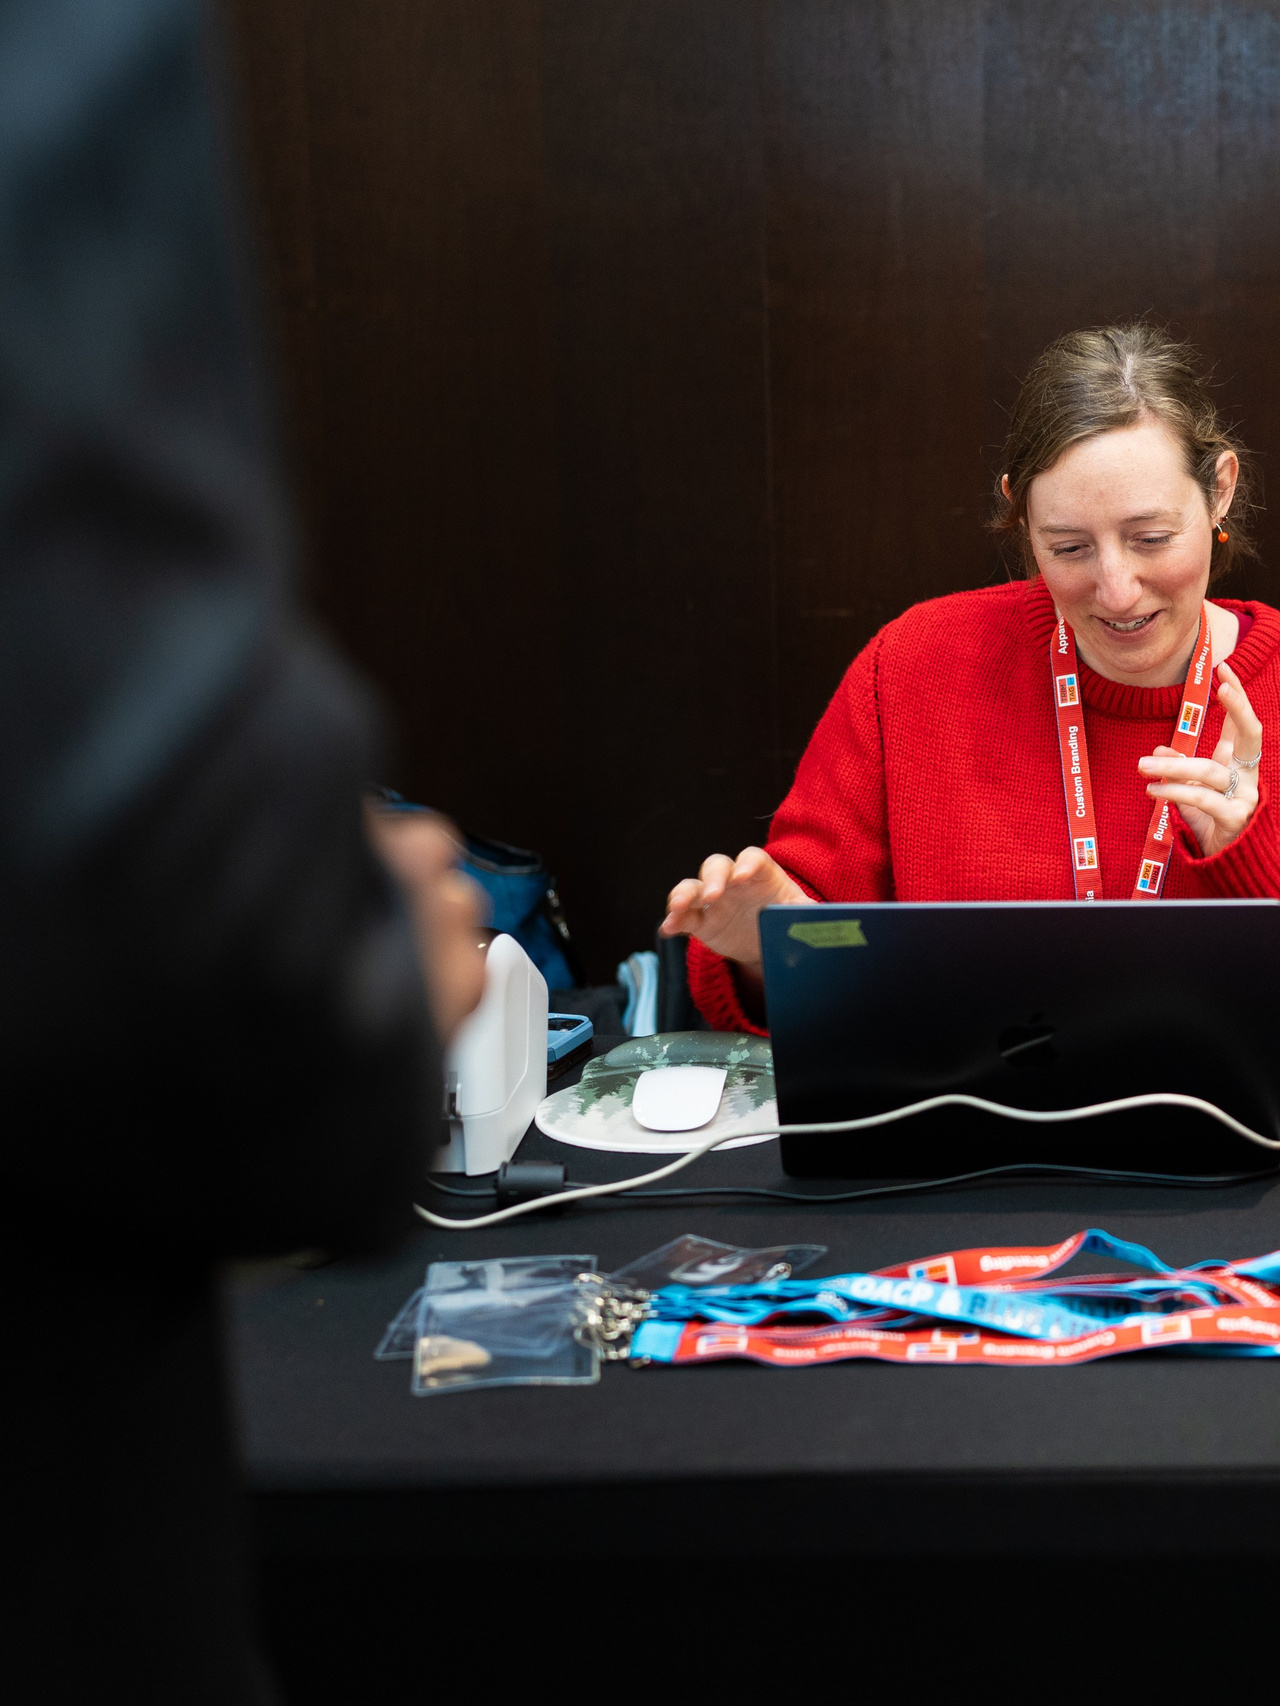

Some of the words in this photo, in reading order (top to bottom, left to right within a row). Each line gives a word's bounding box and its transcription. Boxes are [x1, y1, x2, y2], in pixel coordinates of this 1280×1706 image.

[1058, 614, 1069, 655] Appare
[1193, 645, 1210, 686] Insignia
[1060, 684, 1068, 702] TRIM
[1068, 686, 1076, 701] TAG
[1183, 705, 1193, 721] TAG
[1191, 709, 1200, 728] TRIM
[1068, 725, 1081, 775] Branding
[1073, 776, 1086, 818] Custom
[1153, 800, 1169, 841] anding
[1078, 846, 1086, 866] TRIM
[1142, 864, 1152, 879] TAG
[1150, 866, 1160, 885] TRIM
[851, 1275, 936, 1307] OACP
